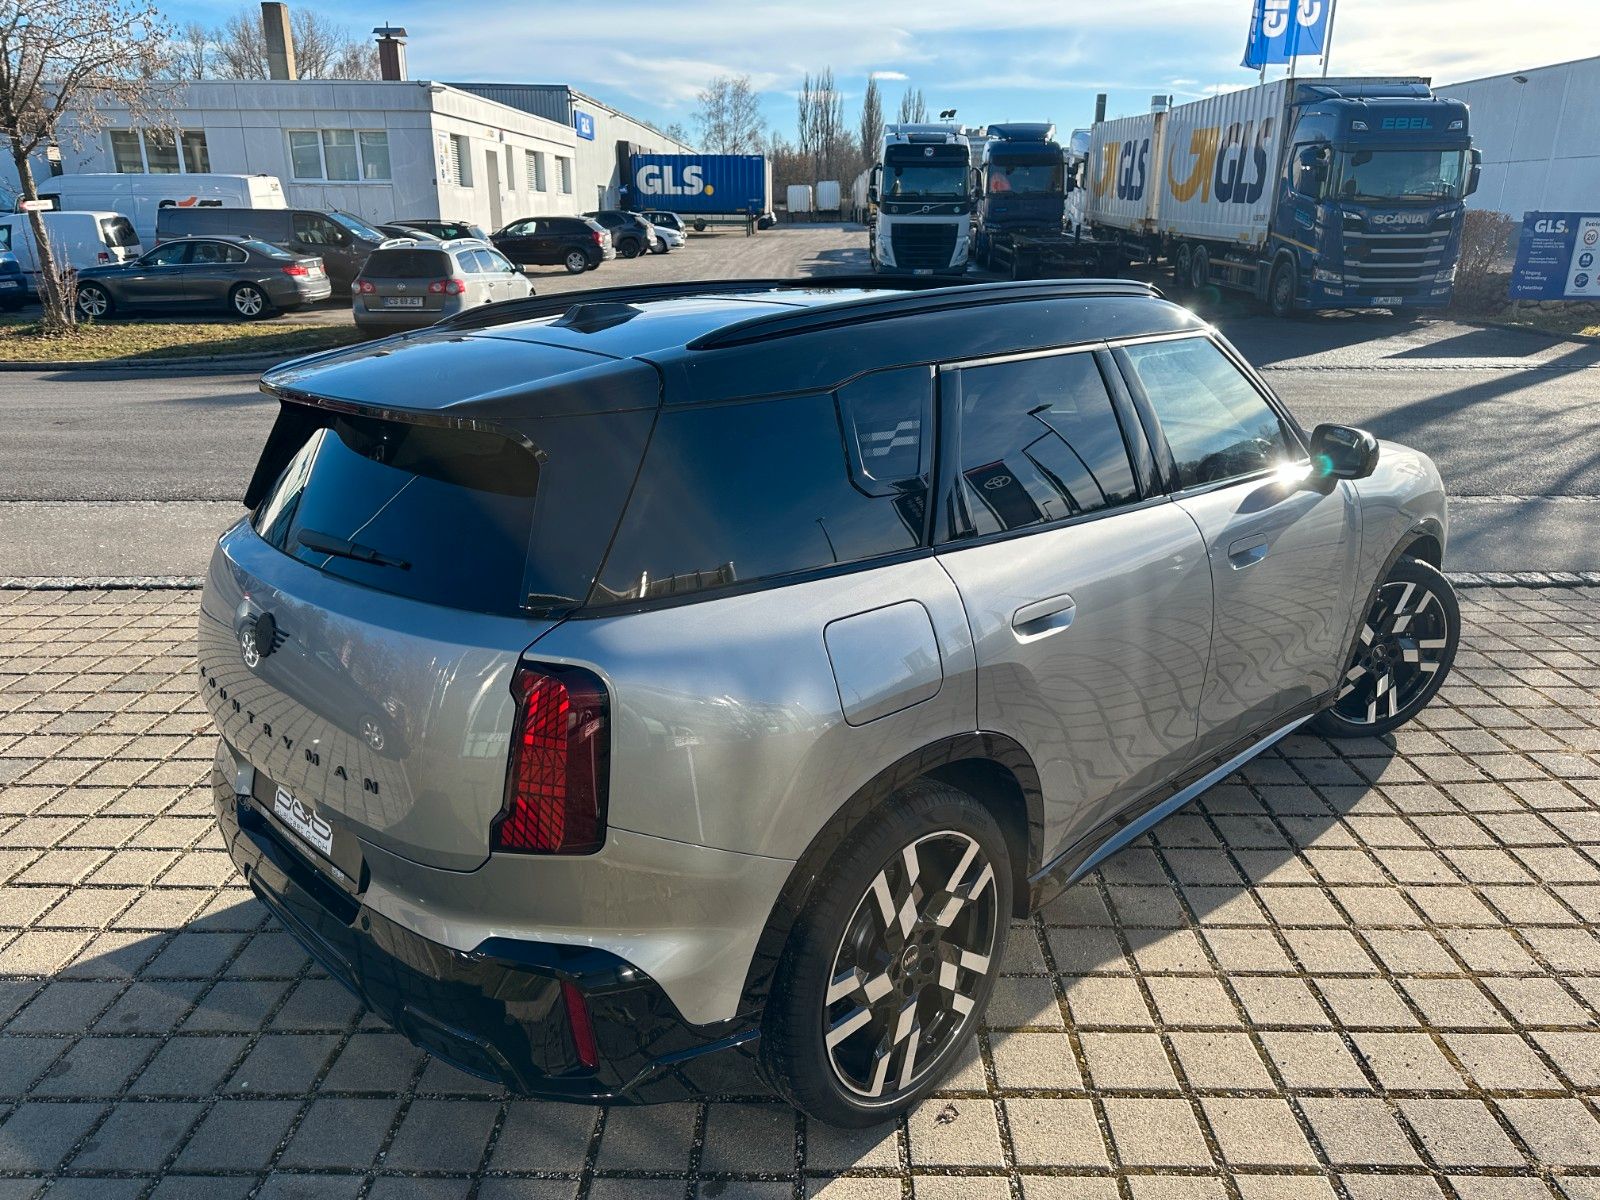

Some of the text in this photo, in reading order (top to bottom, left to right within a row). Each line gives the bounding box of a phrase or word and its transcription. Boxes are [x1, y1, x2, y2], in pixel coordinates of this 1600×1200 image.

[1381, 117, 1433, 130] EBEL
[1117, 138, 1150, 201] GLS
[1215, 117, 1275, 204] GLS
[1373, 214, 1425, 224] SCANIA
